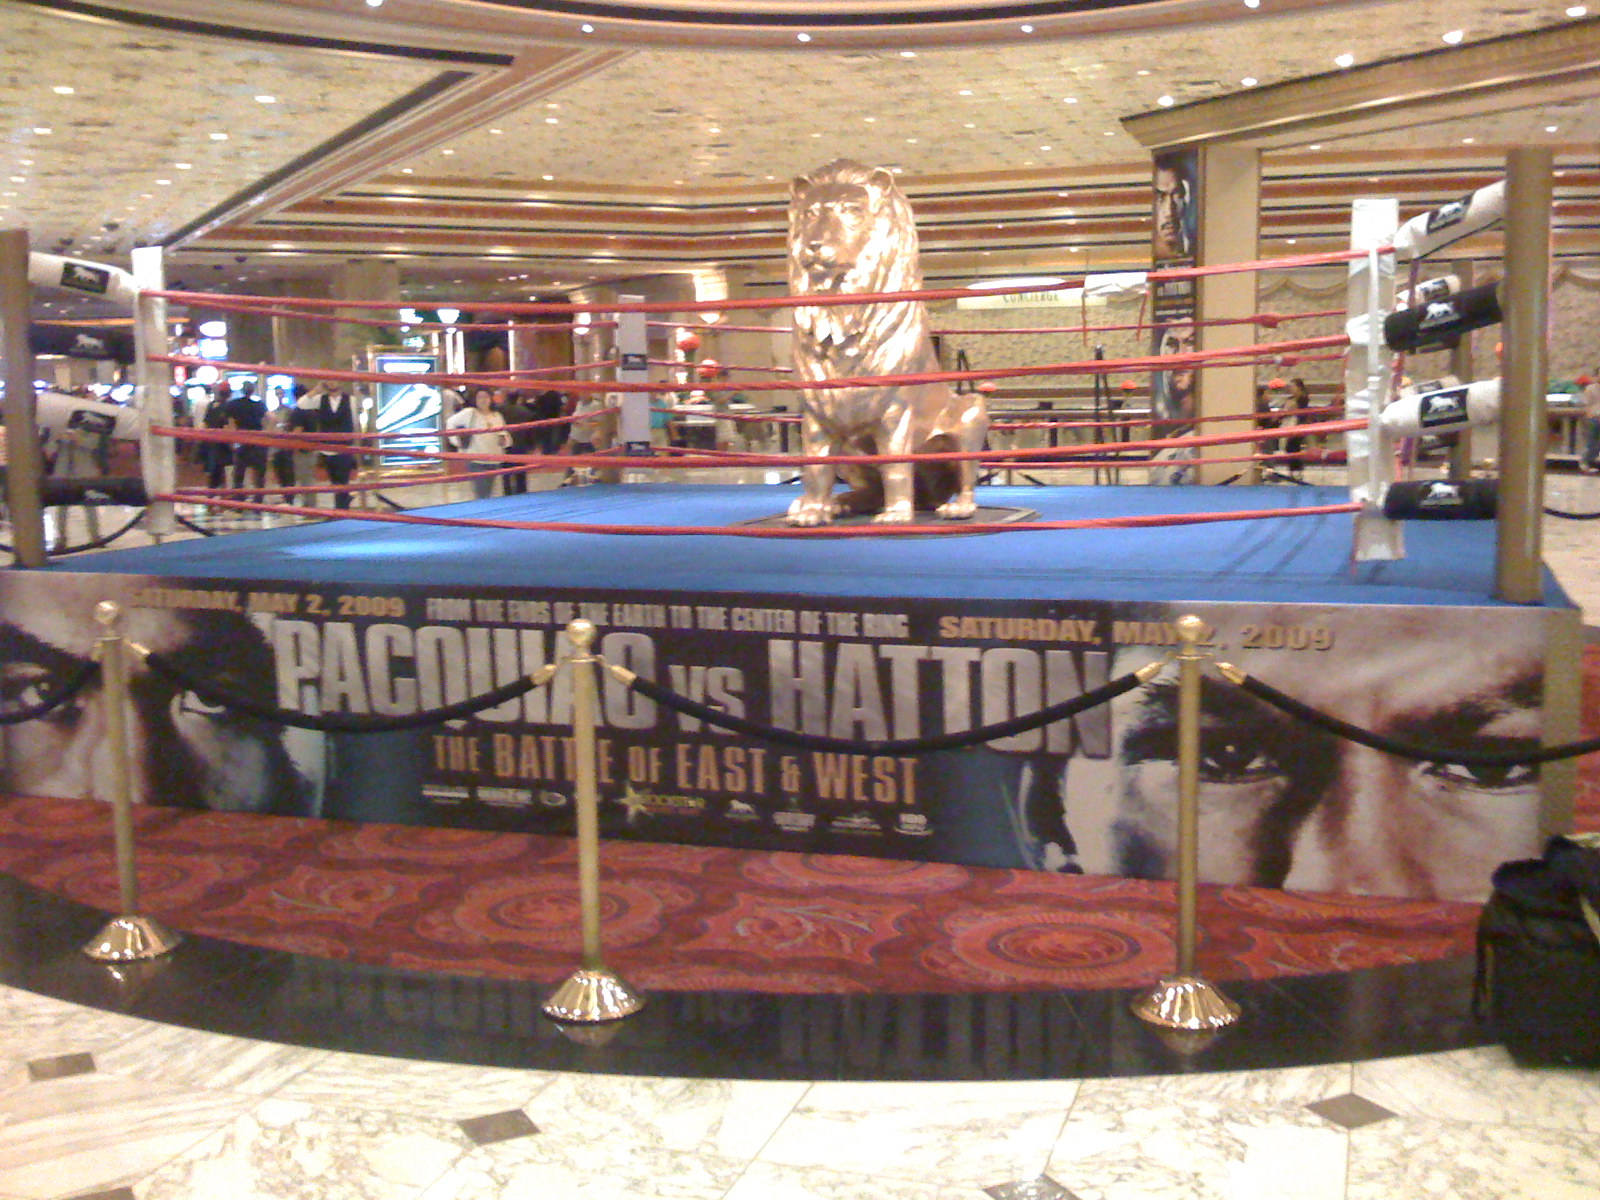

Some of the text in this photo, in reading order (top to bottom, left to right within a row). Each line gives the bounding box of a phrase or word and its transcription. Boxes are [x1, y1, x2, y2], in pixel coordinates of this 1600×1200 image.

[338, 595, 406, 617] 2009
[475, 599, 504, 622] THE
[578, 602, 609, 627] THE
[612, 603, 666, 628] EARTH
[669, 605, 692, 629] TO
[695, 606, 728, 631] THE
[731, 607, 796, 634] CENTER
[799, 610, 822, 635] OF
[825, 611, 859, 637] THE
[1241, 623, 1336, 650] 2009
[768, 639, 1110, 758] HATTON
[432, 733, 918, 805] THE BATTE OF EAST & WEST
